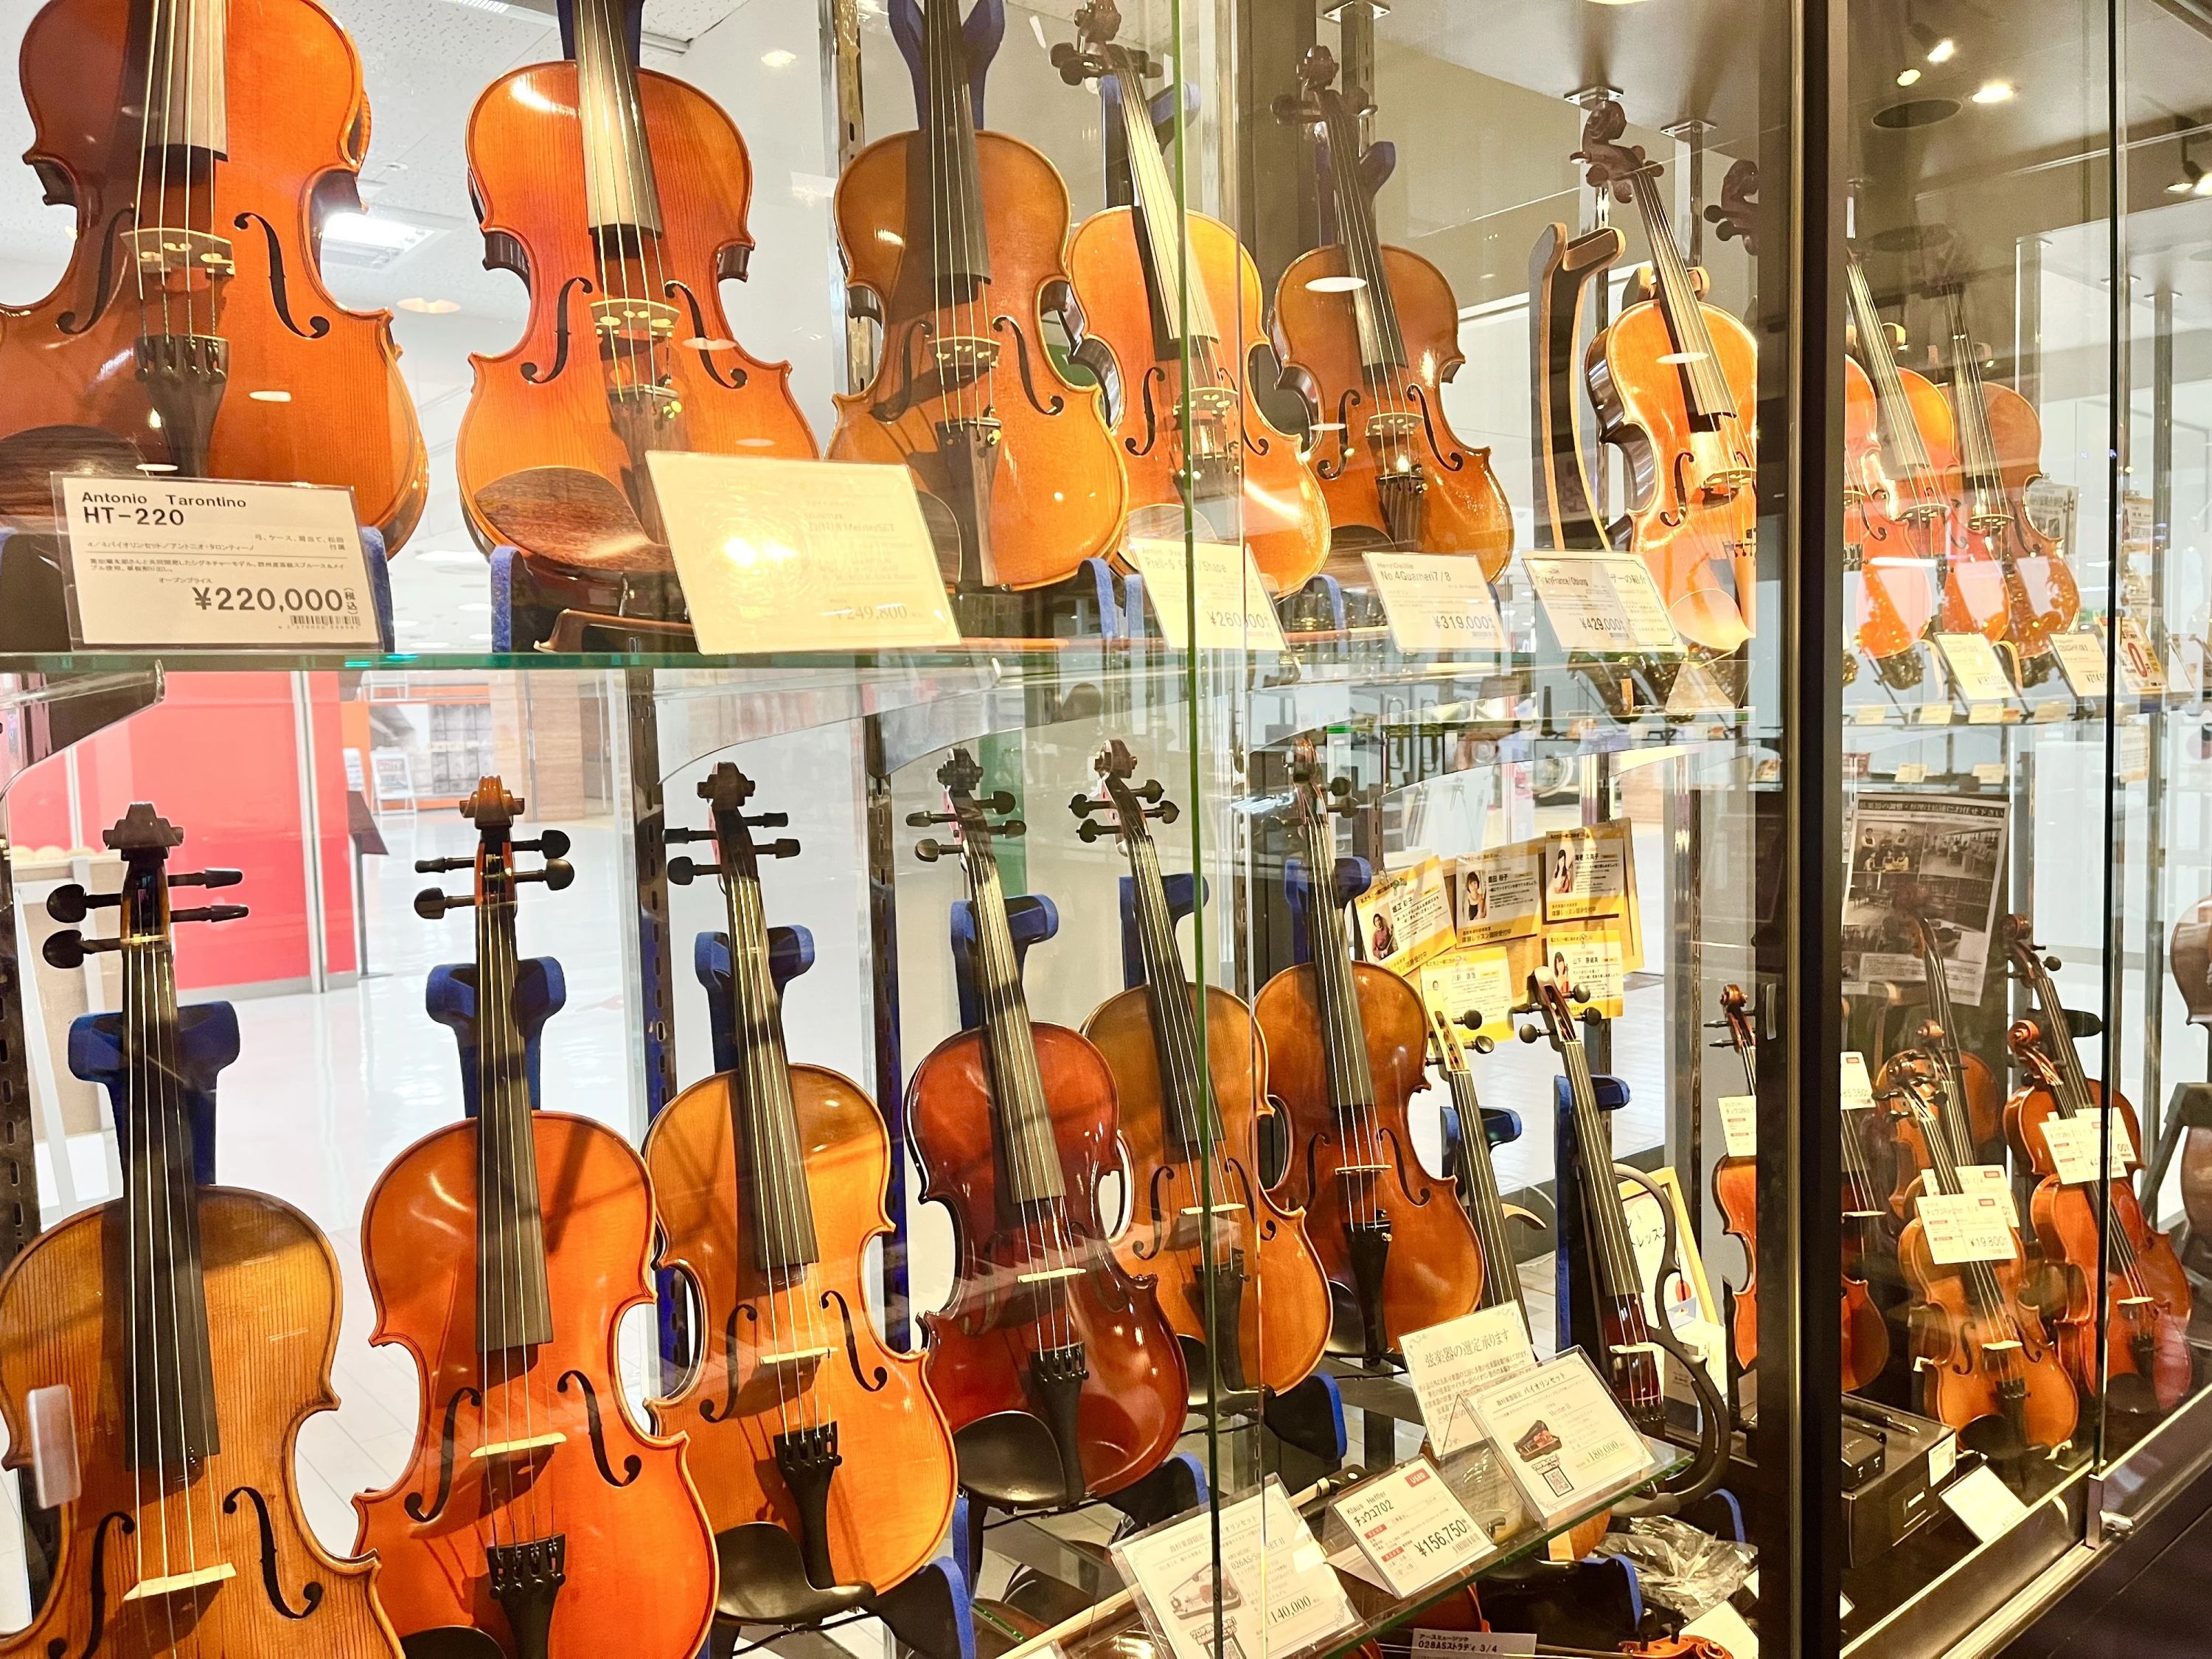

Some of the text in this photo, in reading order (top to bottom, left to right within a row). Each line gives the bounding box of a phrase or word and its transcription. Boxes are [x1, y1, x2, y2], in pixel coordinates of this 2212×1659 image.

[81, 492, 246, 508] Antonio Tarontino
[84, 507, 184, 526] HT-220
[192, 587, 343, 613] ¥220,000
[1207, 611, 1265, 628] ¥26000
[1433, 615, 1489, 630] ¥319,000
[1409, 1472, 1426, 1485] USED
[1346, 1503, 1364, 1514] Klaus
[1220, 1514, 1257, 1535] イオリンセット
[1414, 1519, 1467, 1557] ¥156,750
